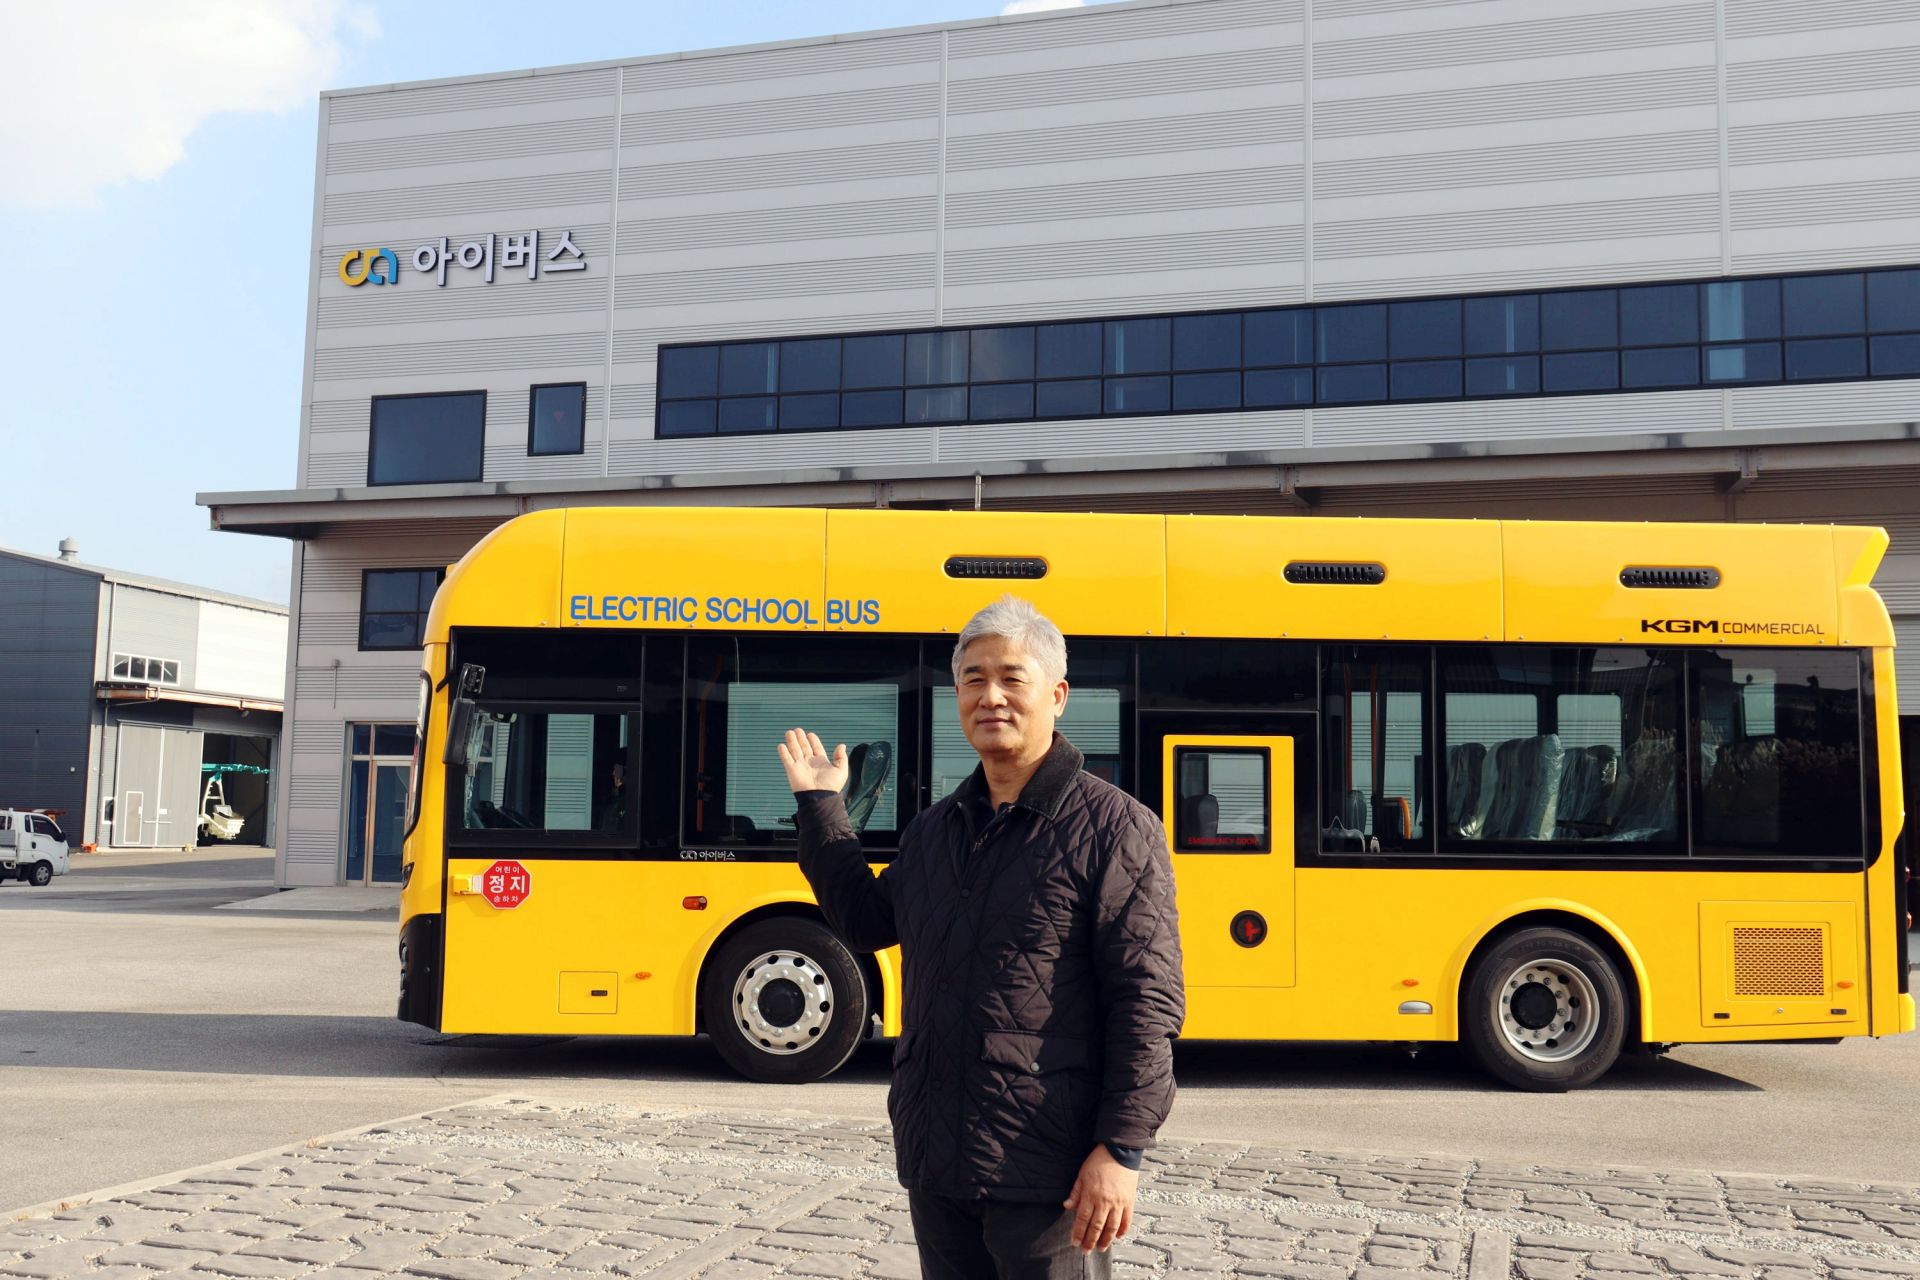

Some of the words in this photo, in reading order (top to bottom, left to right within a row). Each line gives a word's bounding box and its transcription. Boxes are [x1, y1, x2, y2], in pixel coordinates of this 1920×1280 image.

[412, 229, 586, 286] 아이버스
[570, 595, 698, 622] ELECTRIC
[705, 597, 818, 625] SCHOOL
[826, 599, 881, 625] BUS
[1641, 619, 1719, 634] KGM
[1722, 622, 1825, 635] COMMERCIAL
[698, 850, 736, 861] 아이버스
[495, 866, 520, 874] 어린이
[489, 874, 526, 894] 정지
